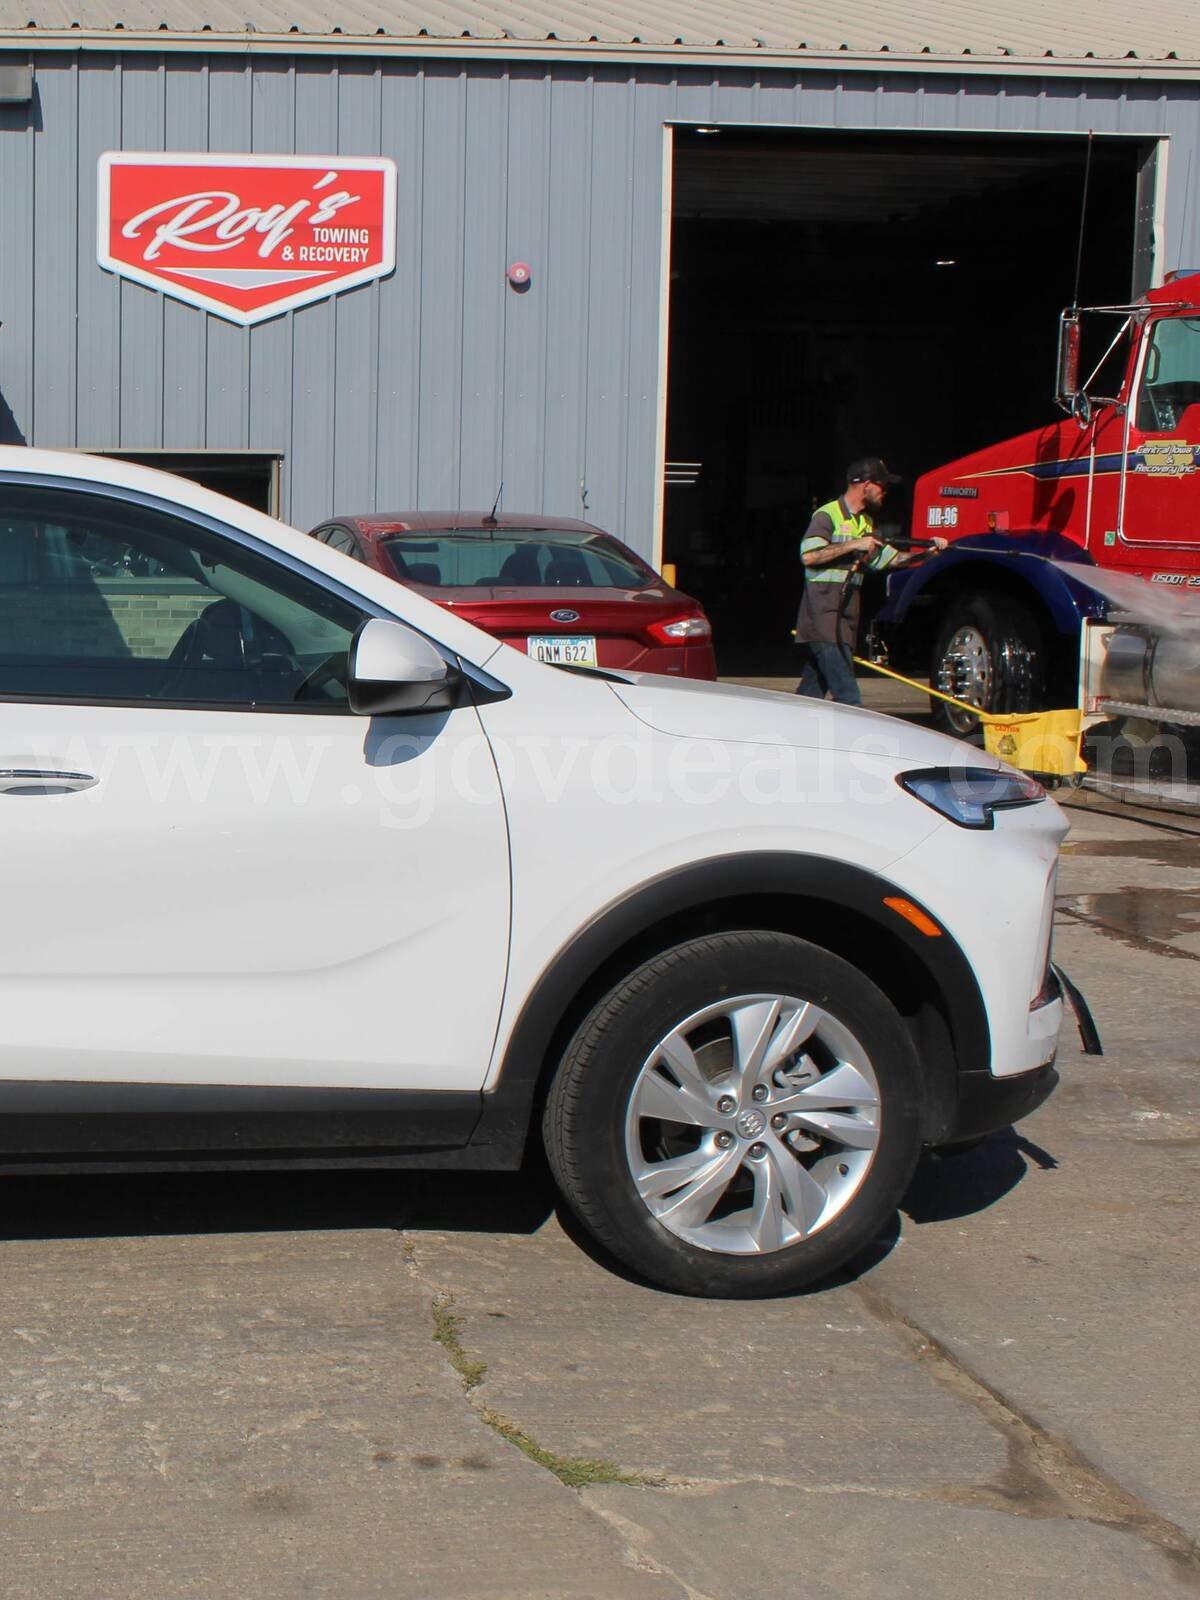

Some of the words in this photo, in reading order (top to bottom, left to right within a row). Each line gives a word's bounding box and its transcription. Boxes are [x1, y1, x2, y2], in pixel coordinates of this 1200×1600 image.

[122, 171, 361, 261] Roy's
[312, 227, 369, 244] TOWING
[281, 245, 295, 261] &
[299, 246, 369, 263] RECOVERY
[1135, 464, 1177, 475] Recovery
[940, 486, 978, 498] KENWORTH
[537, 646, 560, 662] QNM
[564, 646, 587, 661] 622
